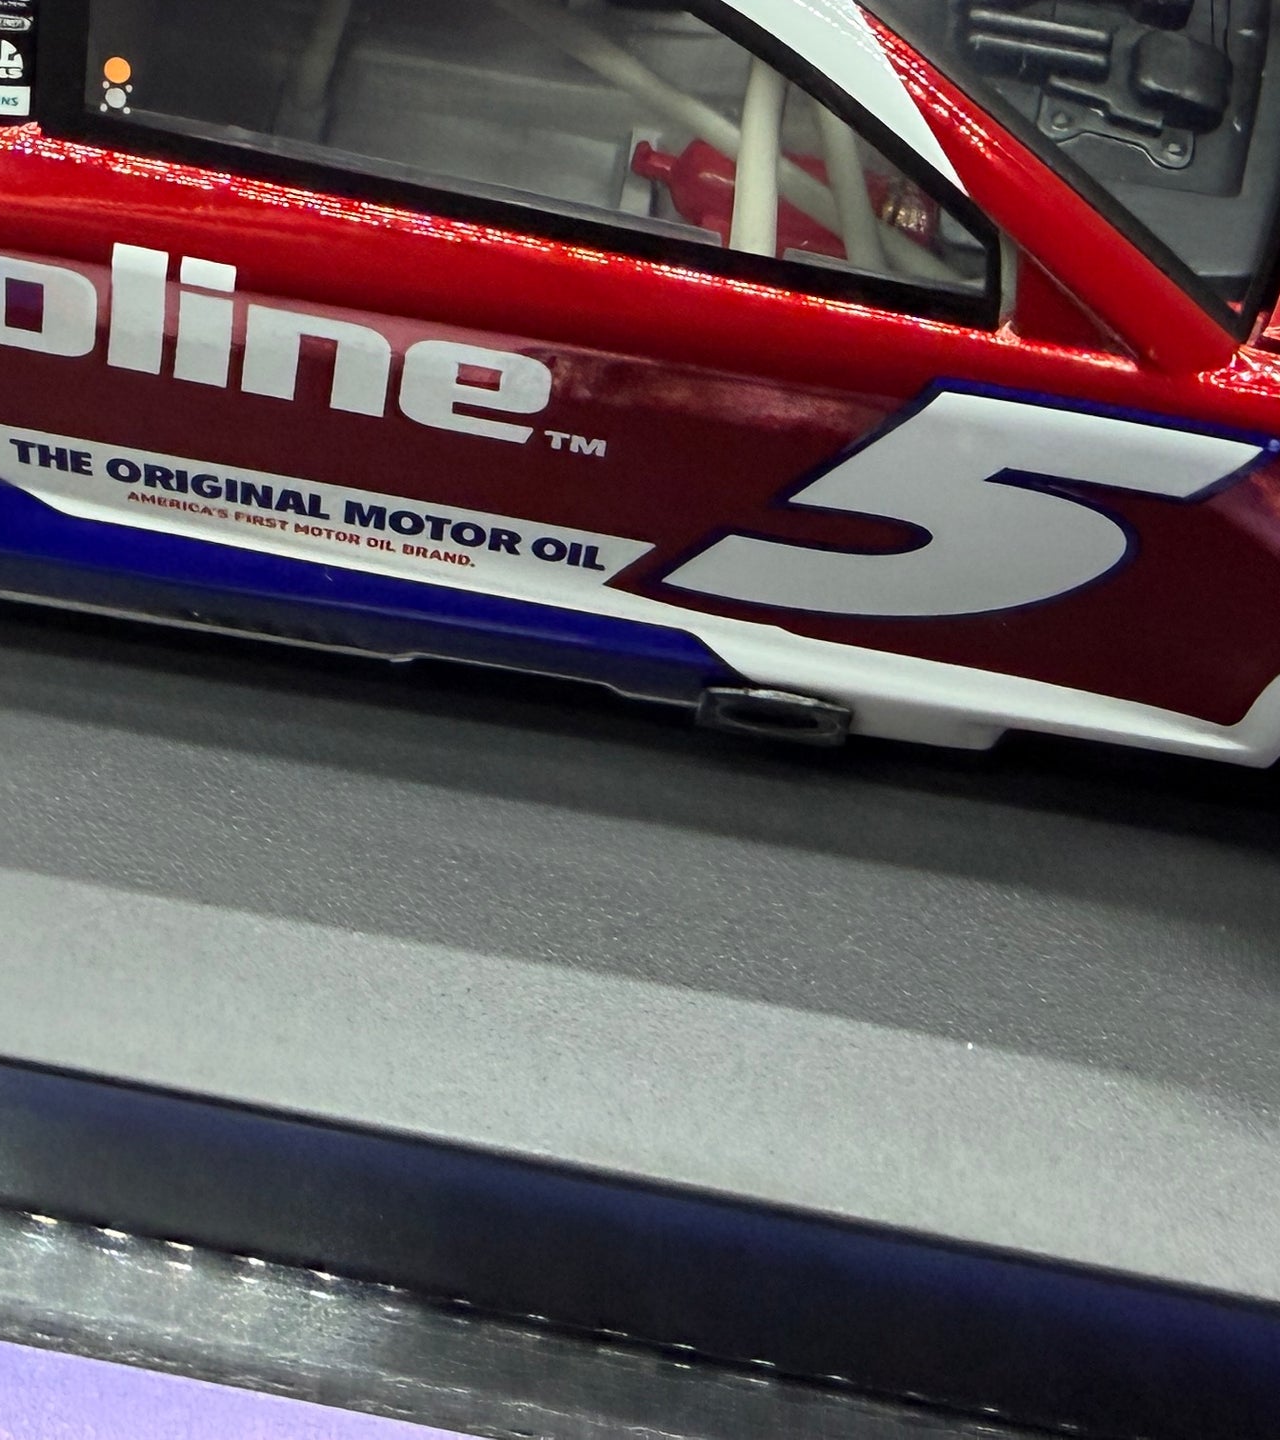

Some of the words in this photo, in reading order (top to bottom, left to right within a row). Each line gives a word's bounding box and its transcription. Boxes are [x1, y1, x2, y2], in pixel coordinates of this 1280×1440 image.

[544, 428, 608, 458] TM
[8, 437, 95, 477] THE
[105, 453, 331, 521] ORIGINAL
[342, 499, 524, 556] MOTOR
[530, 534, 608, 571] OIL
[127, 490, 229, 519] AMERICA'S
[234, 511, 289, 532] FIRST
[294, 523, 361, 546] MOTOR
[366, 536, 397, 553] OIL
[402, 543, 476, 567] BRAND.
[656, 386, 1272, 618] 5
